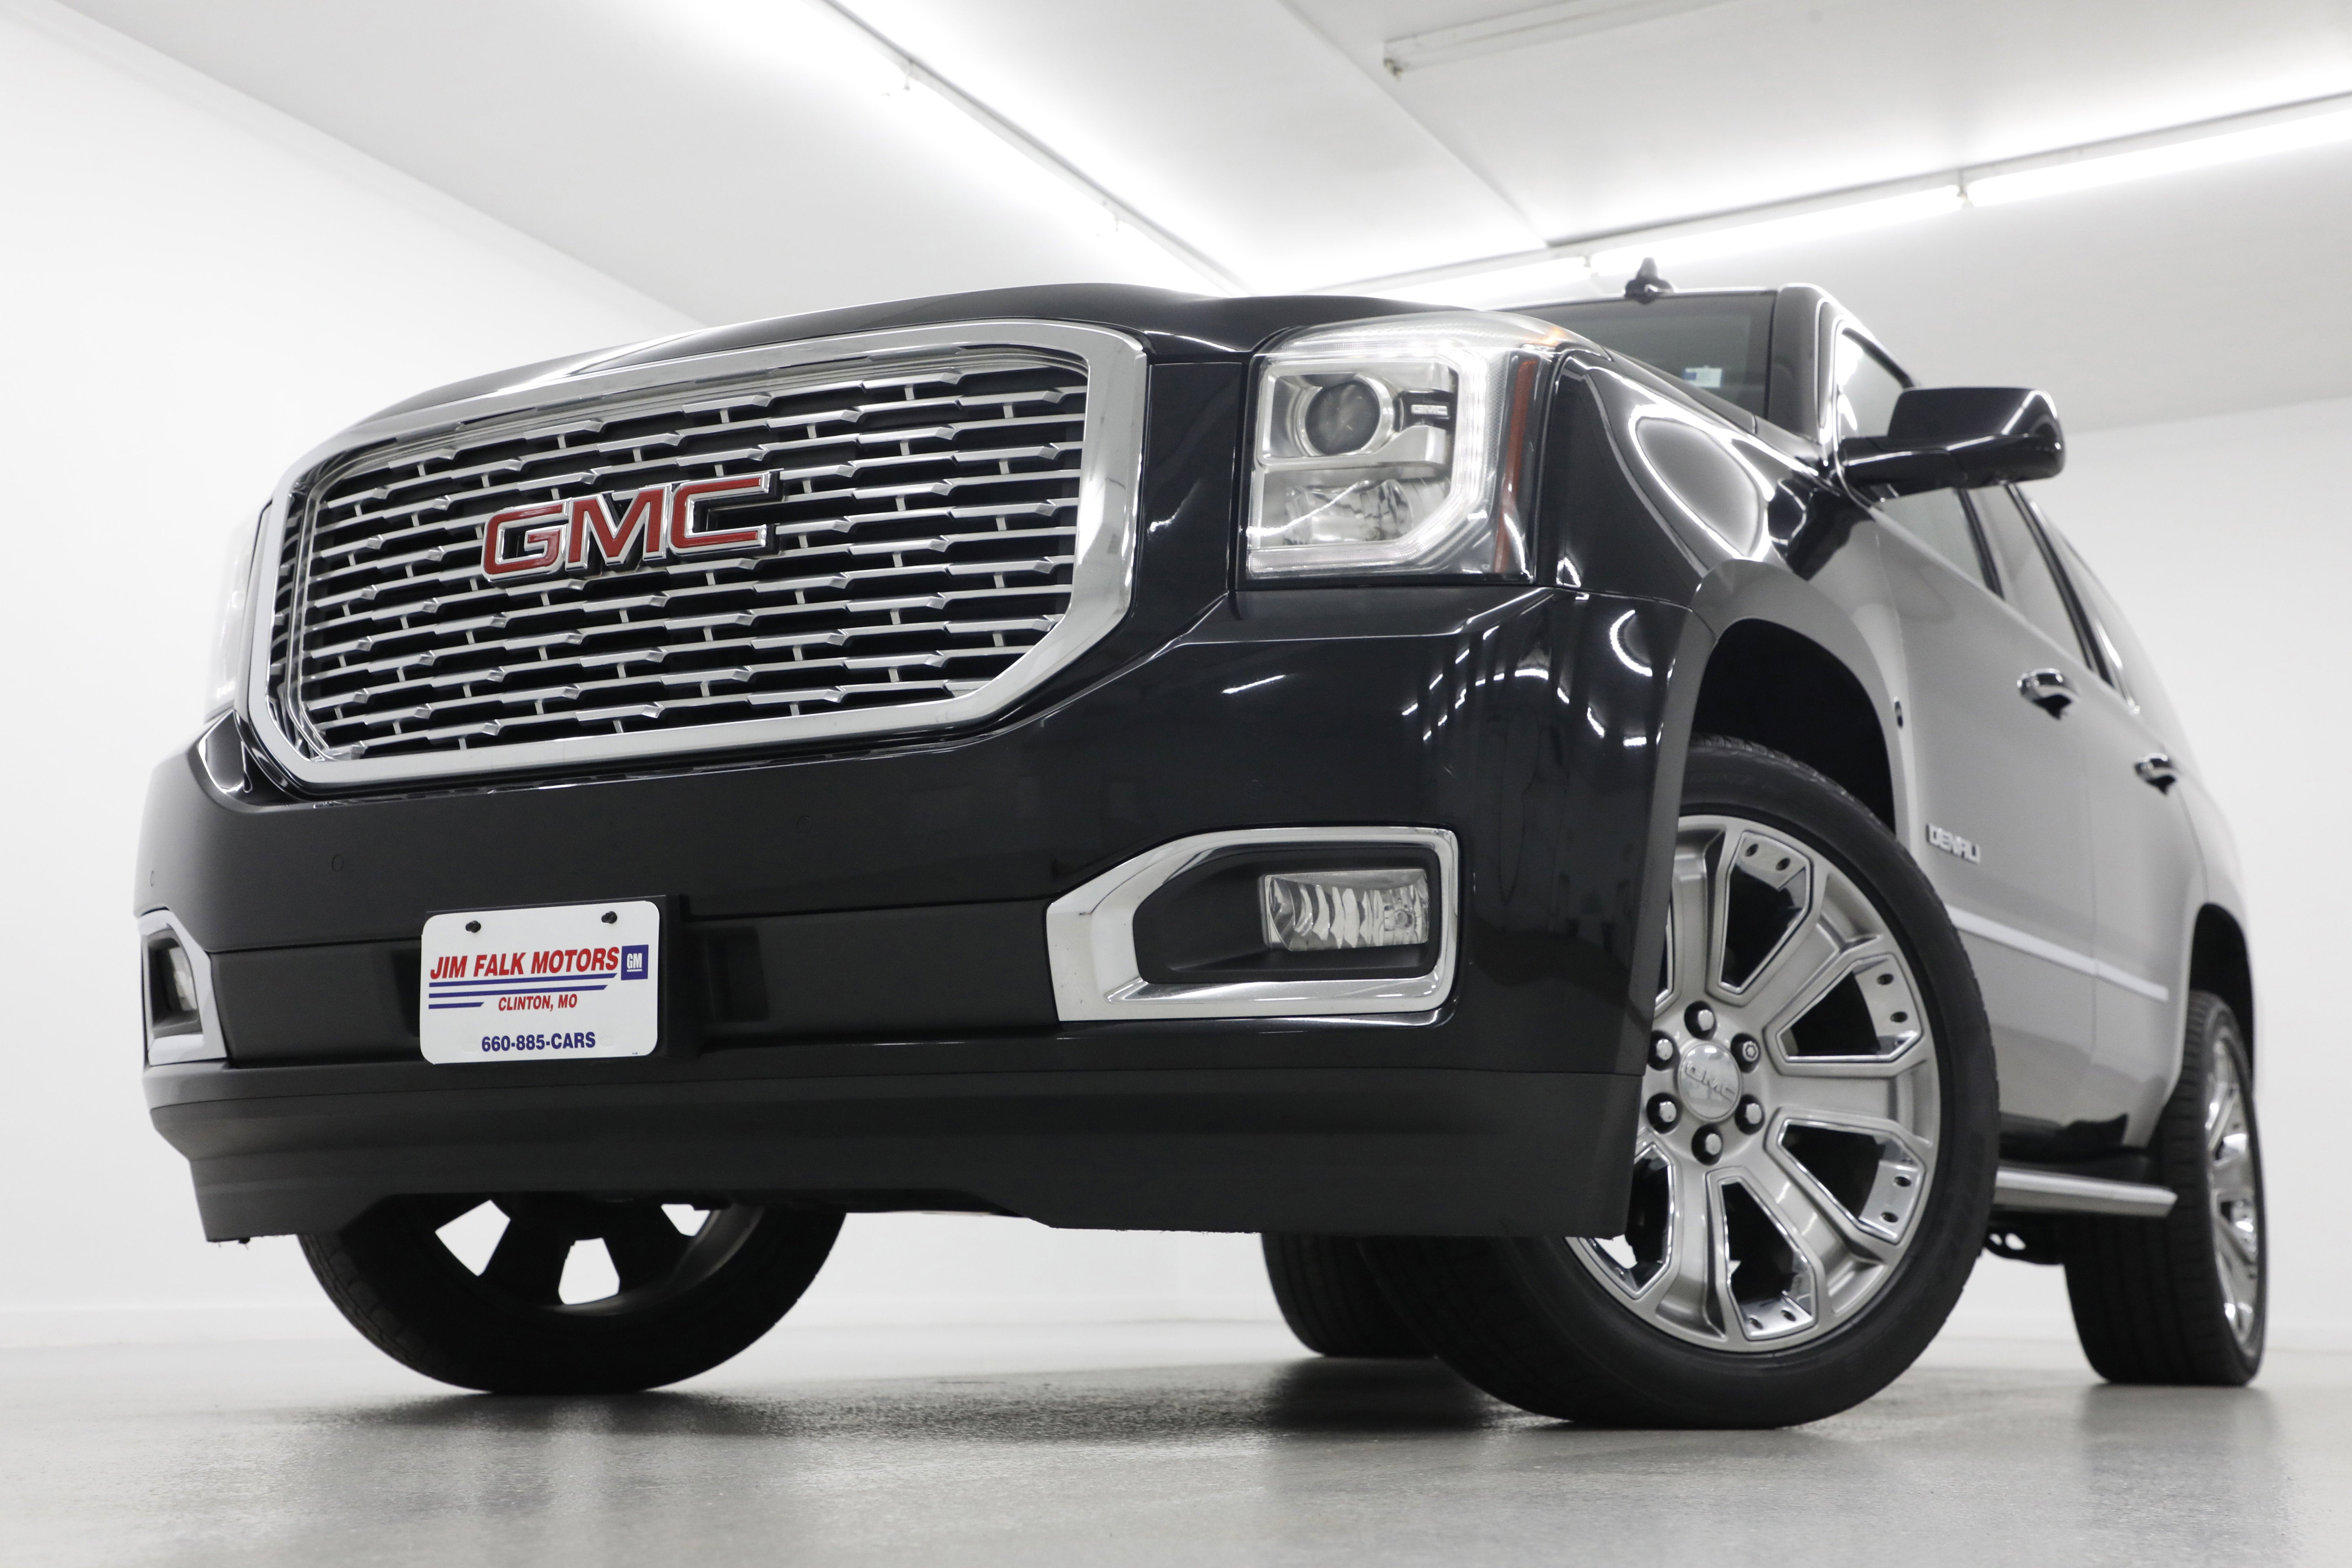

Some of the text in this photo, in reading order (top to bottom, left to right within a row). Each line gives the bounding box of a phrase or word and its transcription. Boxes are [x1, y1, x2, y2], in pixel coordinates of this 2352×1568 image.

[1411, 404, 1448, 416] GMC
[481, 471, 771, 582] GMC
[1925, 823, 1980, 864] DENALI
[430, 947, 620, 980] JIM FALK MOTORS
[626, 953, 643, 969] GM
[498, 993, 578, 1012] CLINTON, MO
[481, 1031, 596, 1052] 660-885-CARS
